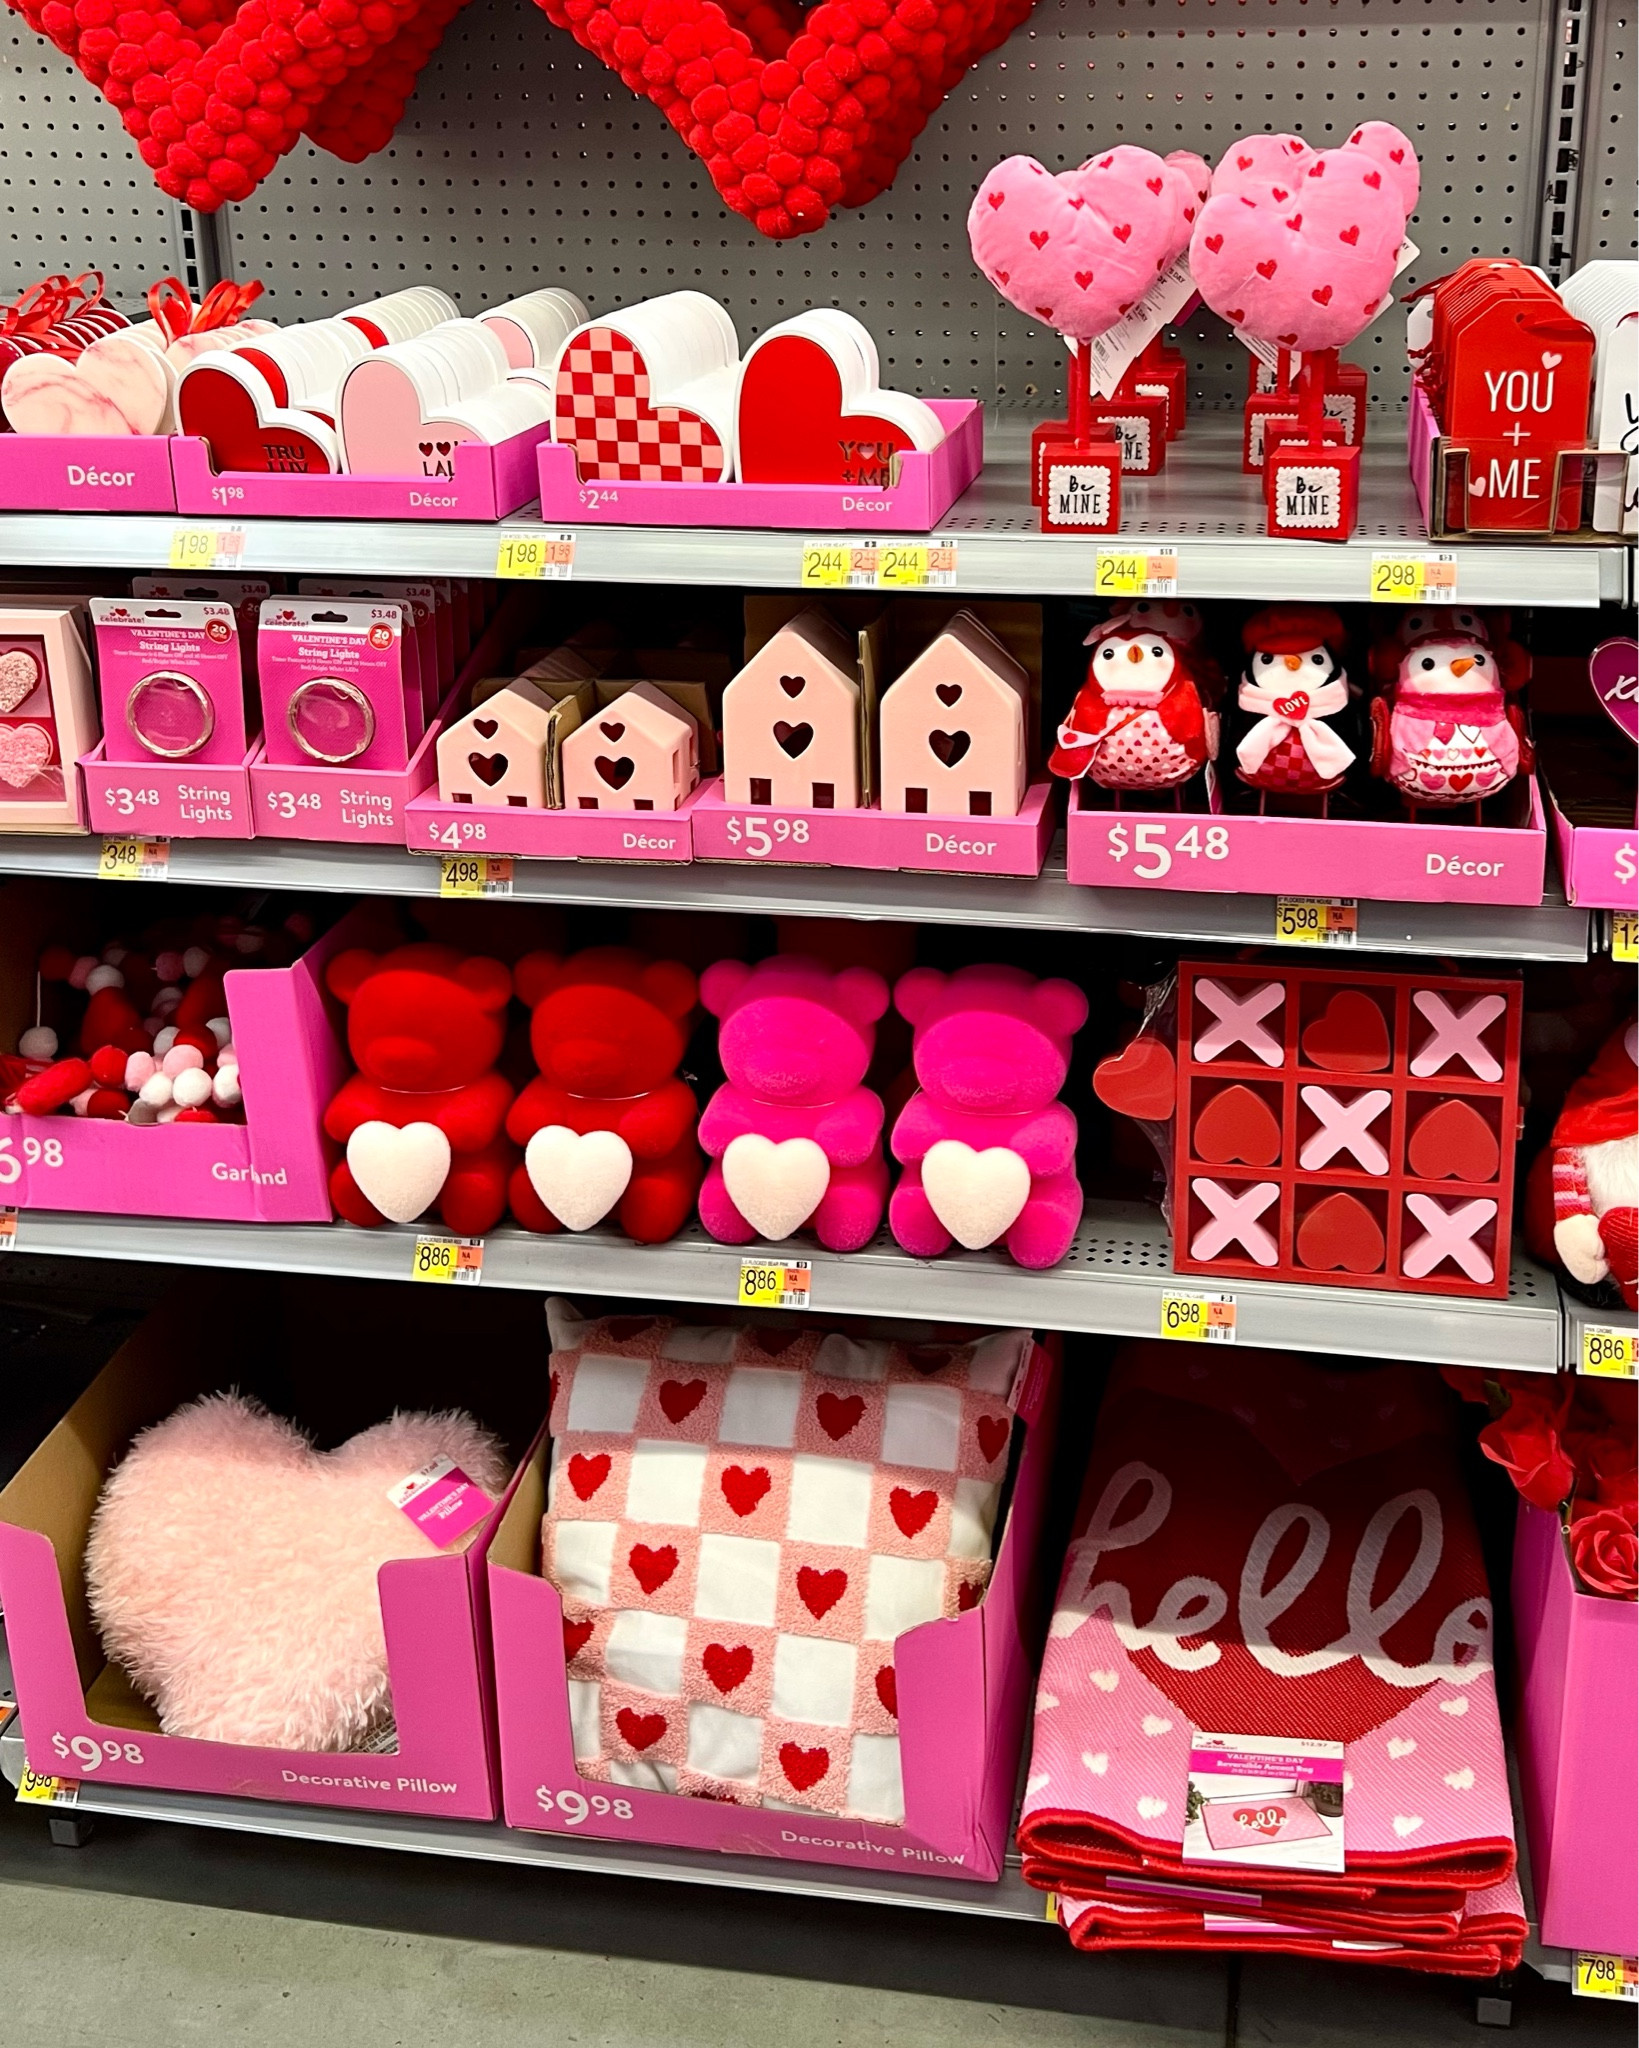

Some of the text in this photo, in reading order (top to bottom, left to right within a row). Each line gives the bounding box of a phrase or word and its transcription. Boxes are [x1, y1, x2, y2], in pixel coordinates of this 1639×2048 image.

[1484, 370, 1554, 413] YOU
[1115, 425, 1137, 441] Be
[263, 444, 305, 460] TRU
[1124, 442, 1142, 460] NE
[67, 464, 136, 487] Décor
[1070, 475, 1095, 492] Be
[1489, 459, 1542, 499] ME
[1296, 476, 1323, 494] Be
[409, 492, 458, 507] Décor
[842, 496, 892, 512] Décor
[1060, 494, 1101, 514] MINE
[1286, 495, 1329, 515] MINE
[406, 588, 431, 597] $3.48
[203, 607, 230, 616] $3.48
[371, 609, 397, 619] $3.48
[130, 629, 205, 640] VALENTINE'S DAY
[211, 624, 227, 634] 20
[374, 629, 389, 639] 20
[139, 641, 200, 653] String Lights
[292, 634, 367, 645] VALENTINE'S DAY
[298, 647, 360, 660] String Lights
[1279, 696, 1308, 715] LOVE
[177, 784, 231, 805] String
[339, 789, 392, 811] String
[180, 804, 233, 823] Lights
[342, 808, 394, 828] Lights
[623, 833, 676, 850] Décor
[926, 833, 997, 856] Décor
[1425, 853, 1504, 878] Décor
[211, 1162, 288, 1185] Garland
[462, 1251, 471, 1260] NA
[788, 1274, 798, 1282] NA
[438, 1499, 463, 1519] Pillow
[1049, 1461, 1494, 1688] hello
[1217, 1760, 1262, 1771] Reversible
[1264, 1763, 1294, 1772] Accent
[1296, 1765, 1314, 1774] Rug
[1227, 1753, 1305, 1765] VALENTINE'S DAY
[282, 1769, 457, 1795] Decorative Pillow
[1239, 1808, 1289, 1830] hello
[781, 1830, 965, 1867] Decorative Pillow
